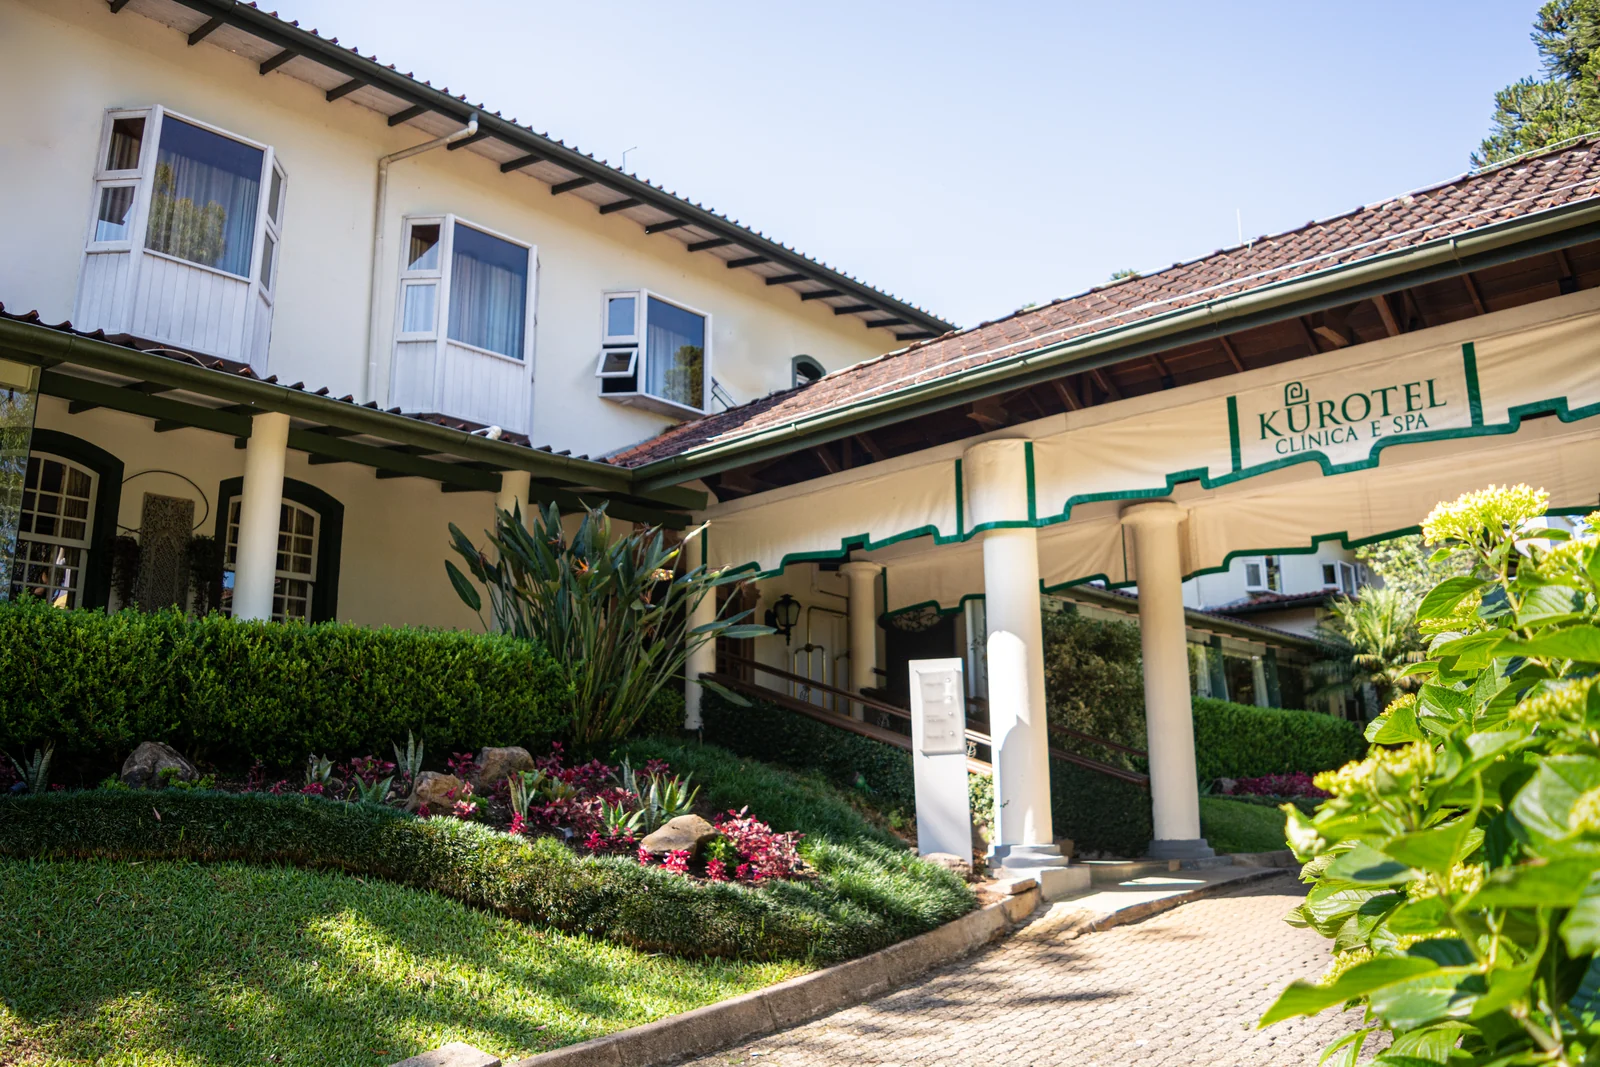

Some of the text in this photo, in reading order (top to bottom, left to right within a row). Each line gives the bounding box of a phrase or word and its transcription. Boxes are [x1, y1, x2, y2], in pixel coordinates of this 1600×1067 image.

[1258, 378, 1447, 440] KUROTEL
[1371, 420, 1382, 438] E
[1393, 412, 1429, 434] SPA
